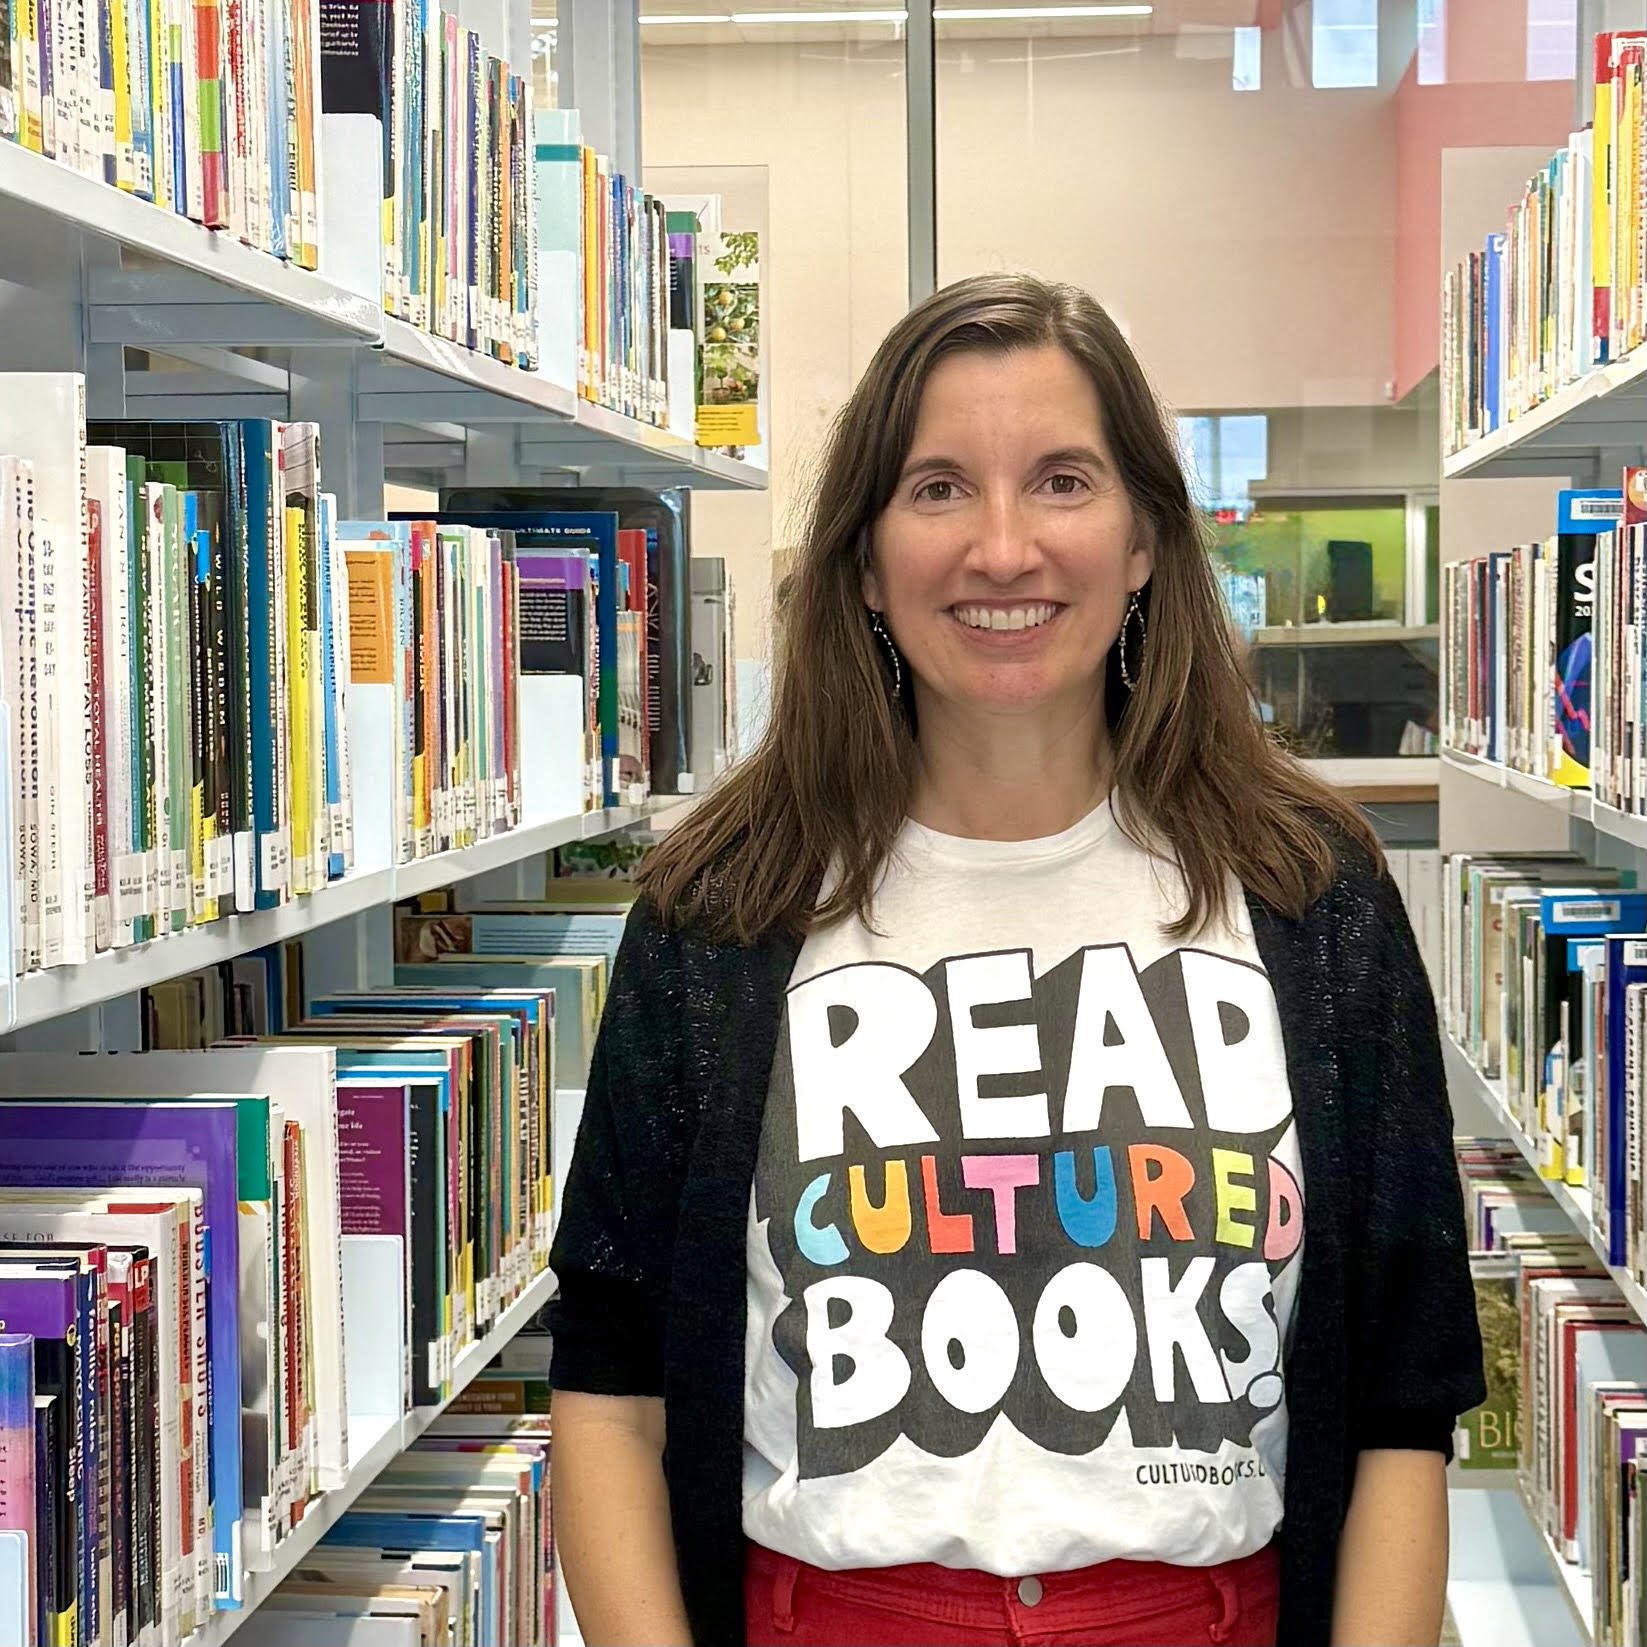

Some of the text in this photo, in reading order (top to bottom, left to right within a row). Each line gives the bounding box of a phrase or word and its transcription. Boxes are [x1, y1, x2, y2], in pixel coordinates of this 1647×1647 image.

[79, 428, 88, 546] STRENGTH
[25, 530, 36, 648] Ozempic
[82, 557, 90, 659] TRAINING
[1574, 605, 1592, 616] 20
[29, 656, 39, 800] Revolution
[218, 630, 226, 725] WISDOM
[94, 754, 102, 826] HEALTH
[786, 944, 1293, 1162] READ
[794, 1144, 1303, 1266] CULTURED
[86, 1308, 96, 1453] fertility rules
[114, 1368, 122, 1476] GOODNESS
[66, 1447, 76, 1502] Sleep
[76, 1404, 84, 1480] CLINIC
